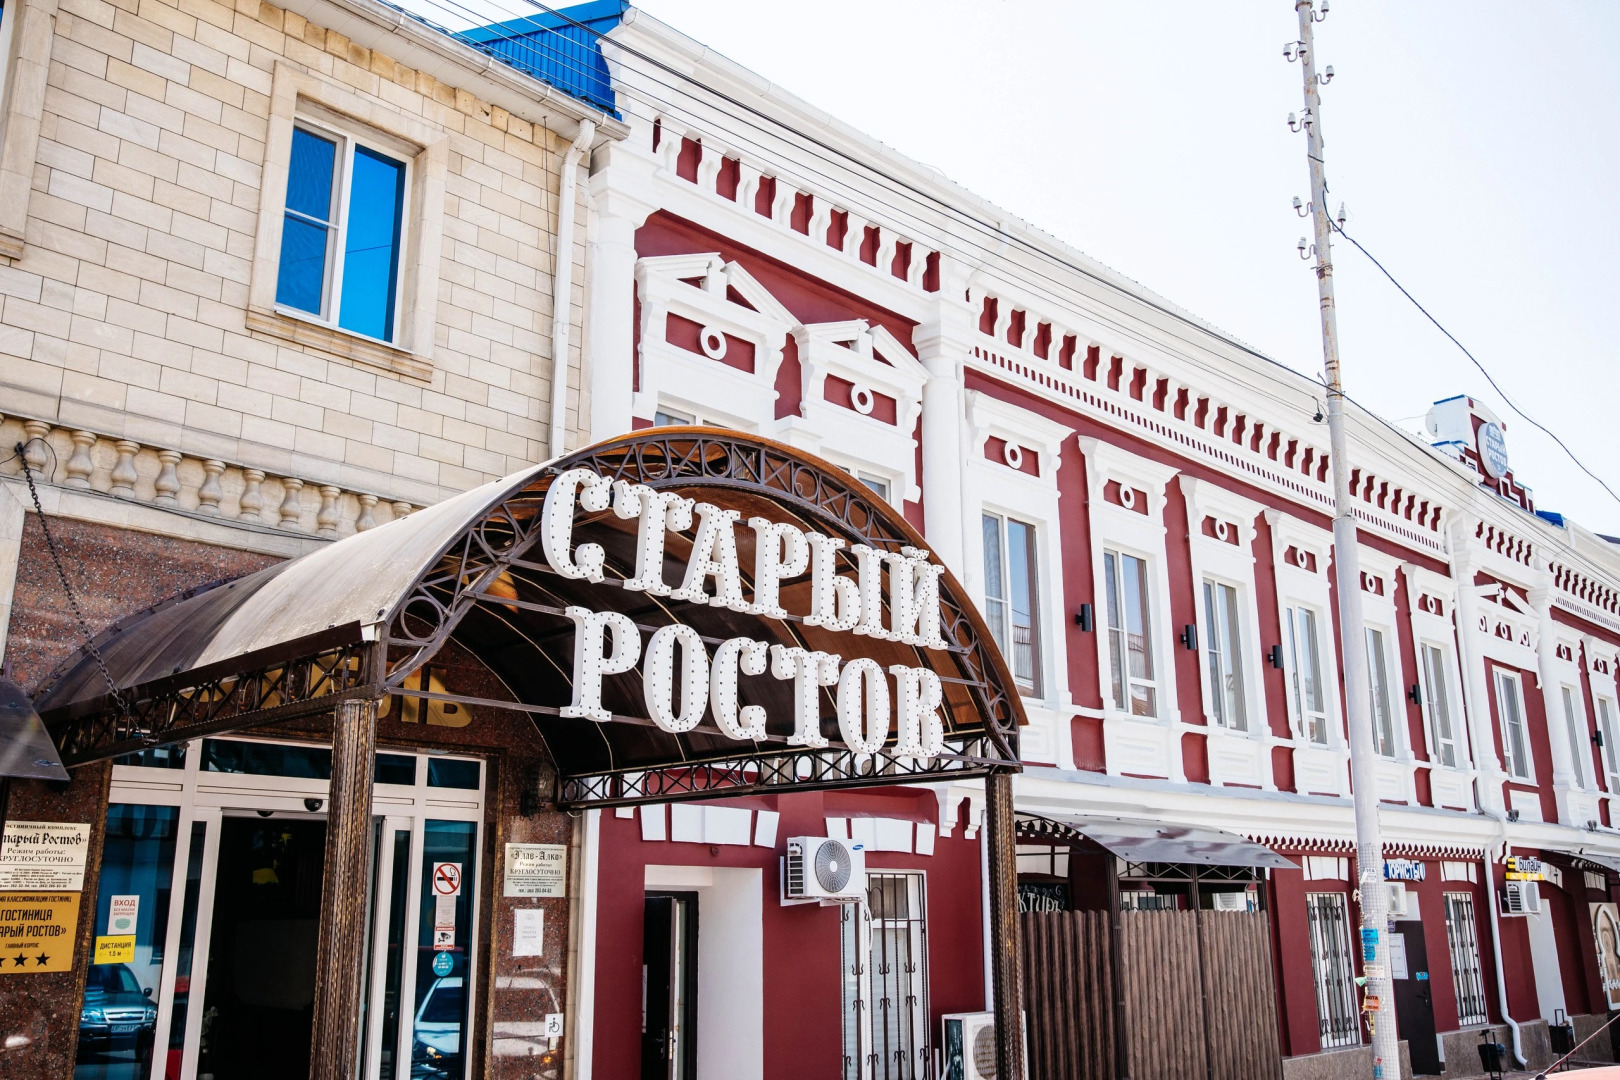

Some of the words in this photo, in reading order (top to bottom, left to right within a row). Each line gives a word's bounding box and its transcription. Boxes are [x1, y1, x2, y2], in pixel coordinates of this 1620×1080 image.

[541, 468, 948, 650] СТАРЫЙ
[559, 606, 944, 759] РОСТОВ
[2, 832, 40, 848] тарый
[7, 847, 34, 855] Режим
[35, 848, 66, 856] работы:
[1387, 861, 1420, 880] ЮРИСТЫ
[1519, 857, 1541, 872] билайн
[48, 895, 72, 903] ГОСТИНИЦ
[114, 899, 136, 907] ВХОД
[0, 909, 53, 922] ГОСТИНИЦА
[26, 924, 67, 937] РОСТОВ»
[99, 942, 132, 950] ДИСТАНЦИЯ
